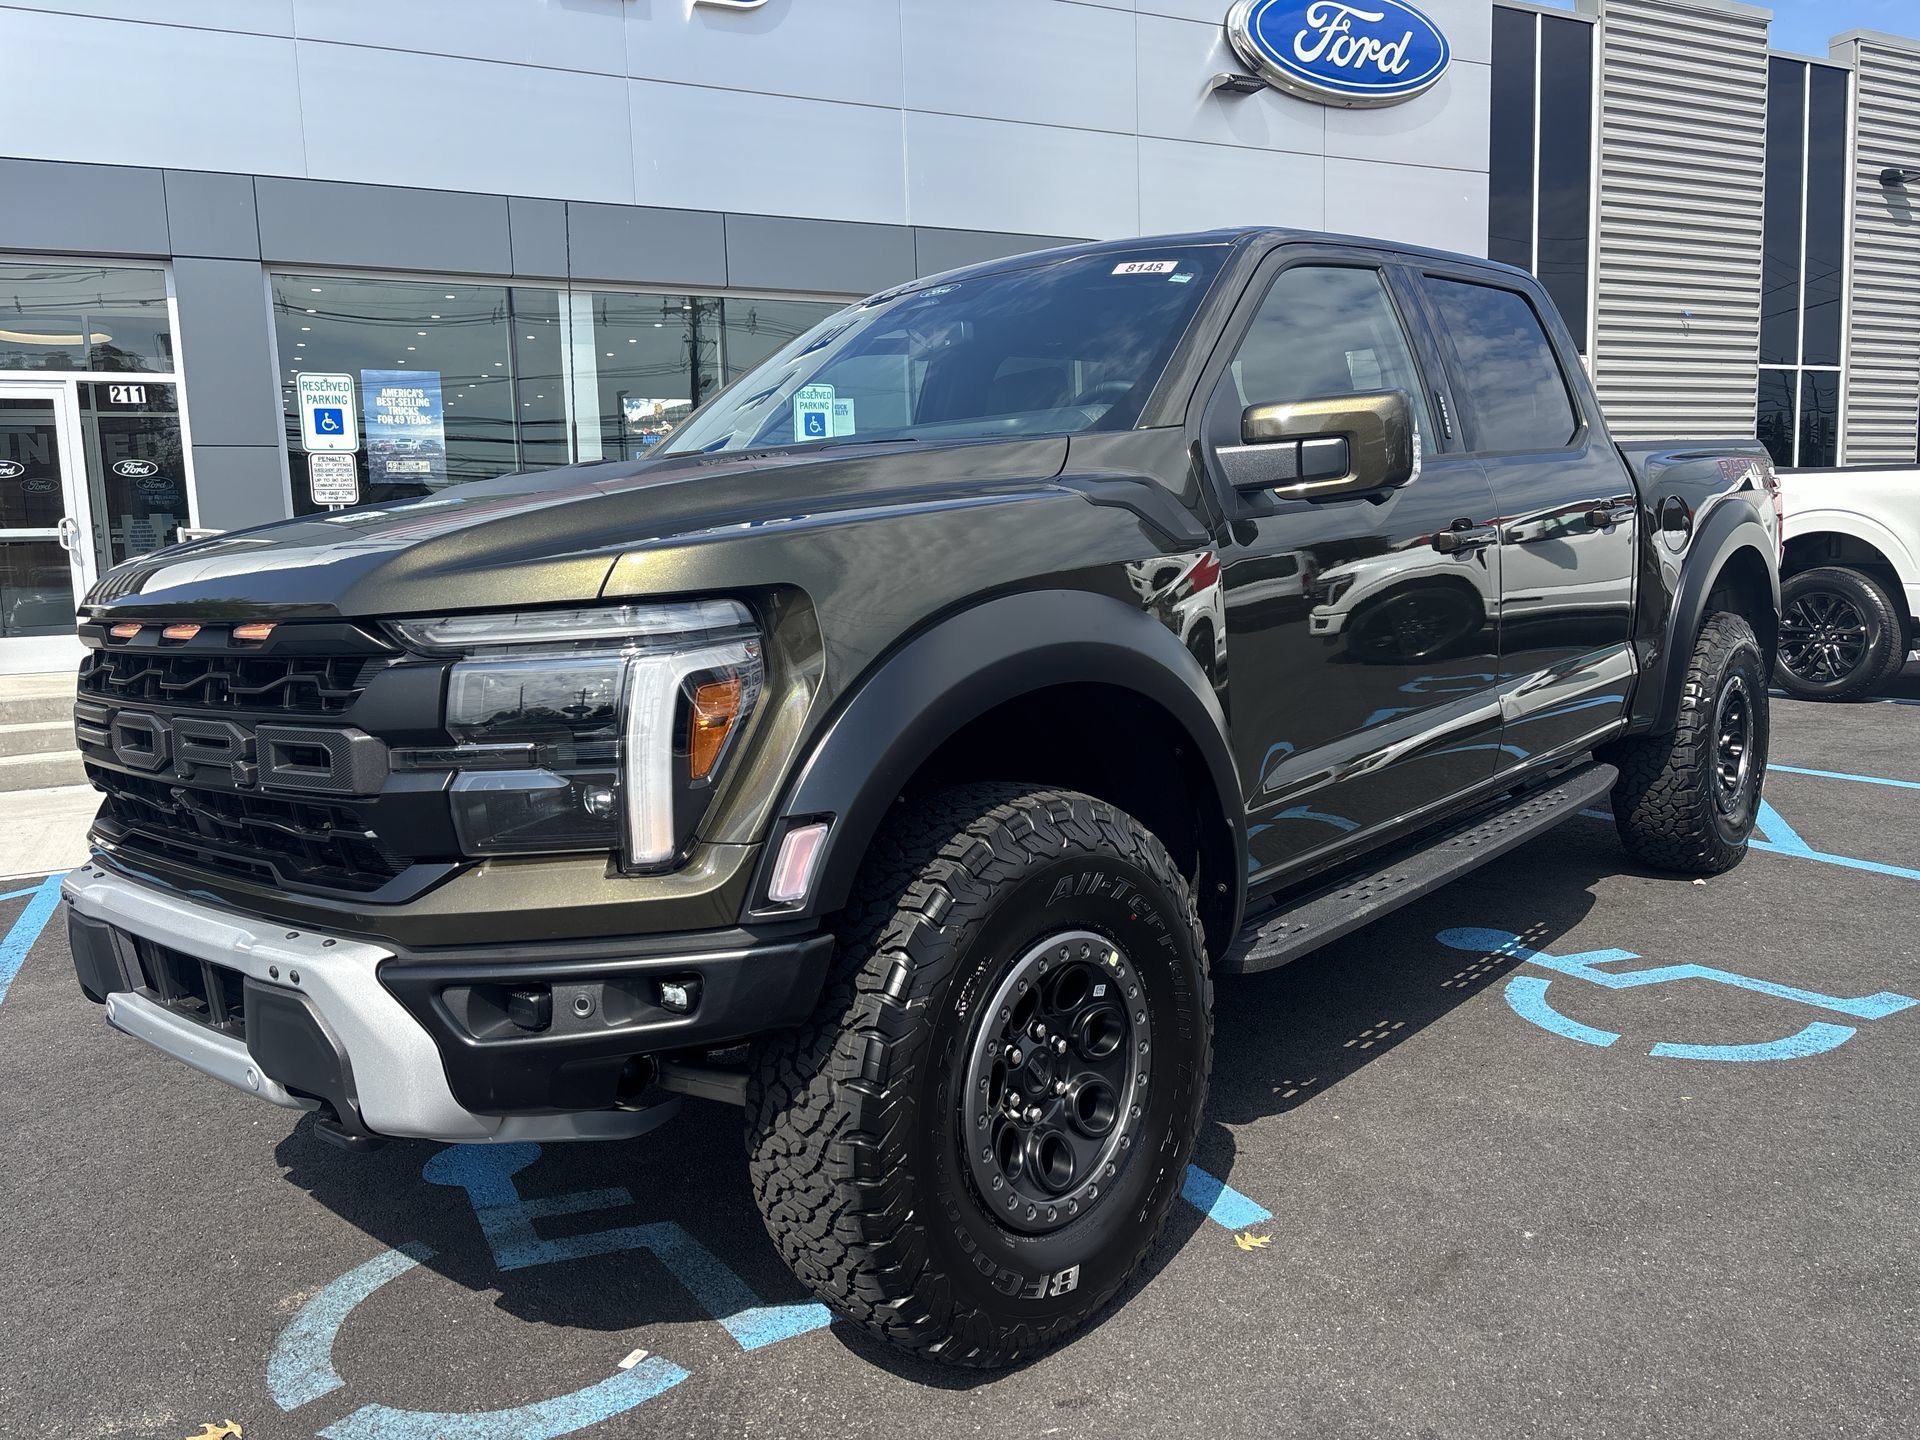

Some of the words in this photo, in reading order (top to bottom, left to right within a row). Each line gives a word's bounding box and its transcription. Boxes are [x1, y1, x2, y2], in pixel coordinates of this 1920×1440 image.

[1294, 1, 1413, 75] Ford
[1125, 263, 1164, 272] 8148
[302, 381, 350, 392] RESERVED
[111, 386, 144, 402] 211
[381, 388, 424, 398] AMERICA'S
[797, 391, 832, 399] RESERVED
[306, 394, 348, 405] PARKING
[376, 397, 430, 407] BEST-SELLING
[388, 406, 419, 416] TRUCKS
[799, 402, 829, 410] PARKING
[377, 415, 394, 424] FOR
[394, 415, 405, 424] 49
[406, 415, 432, 425] YEARS
[121, 461, 149, 474] Ford
[74, 701, 390, 795] FORD
